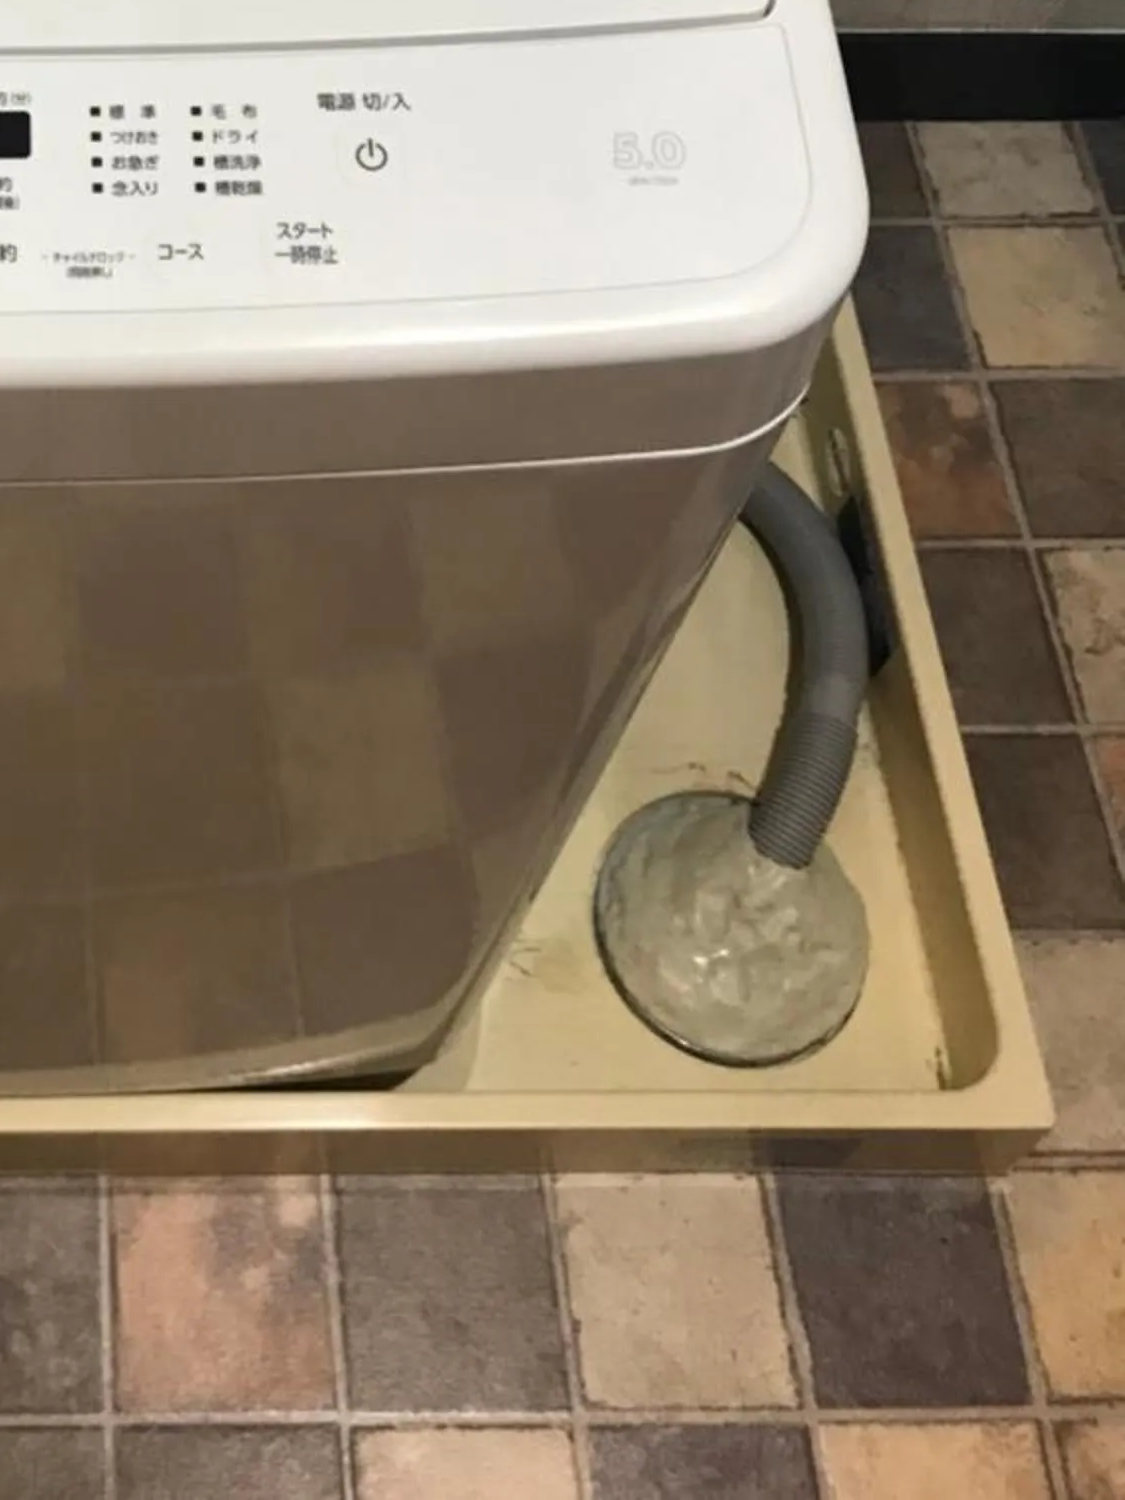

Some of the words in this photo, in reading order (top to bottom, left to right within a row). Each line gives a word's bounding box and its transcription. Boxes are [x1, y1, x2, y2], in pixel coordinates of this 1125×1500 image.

[612, 131, 687, 170] 5.0
[277, 222, 333, 240] スタート
[159, 243, 204, 260] コース
[275, 244, 338, 265] 一時停止
